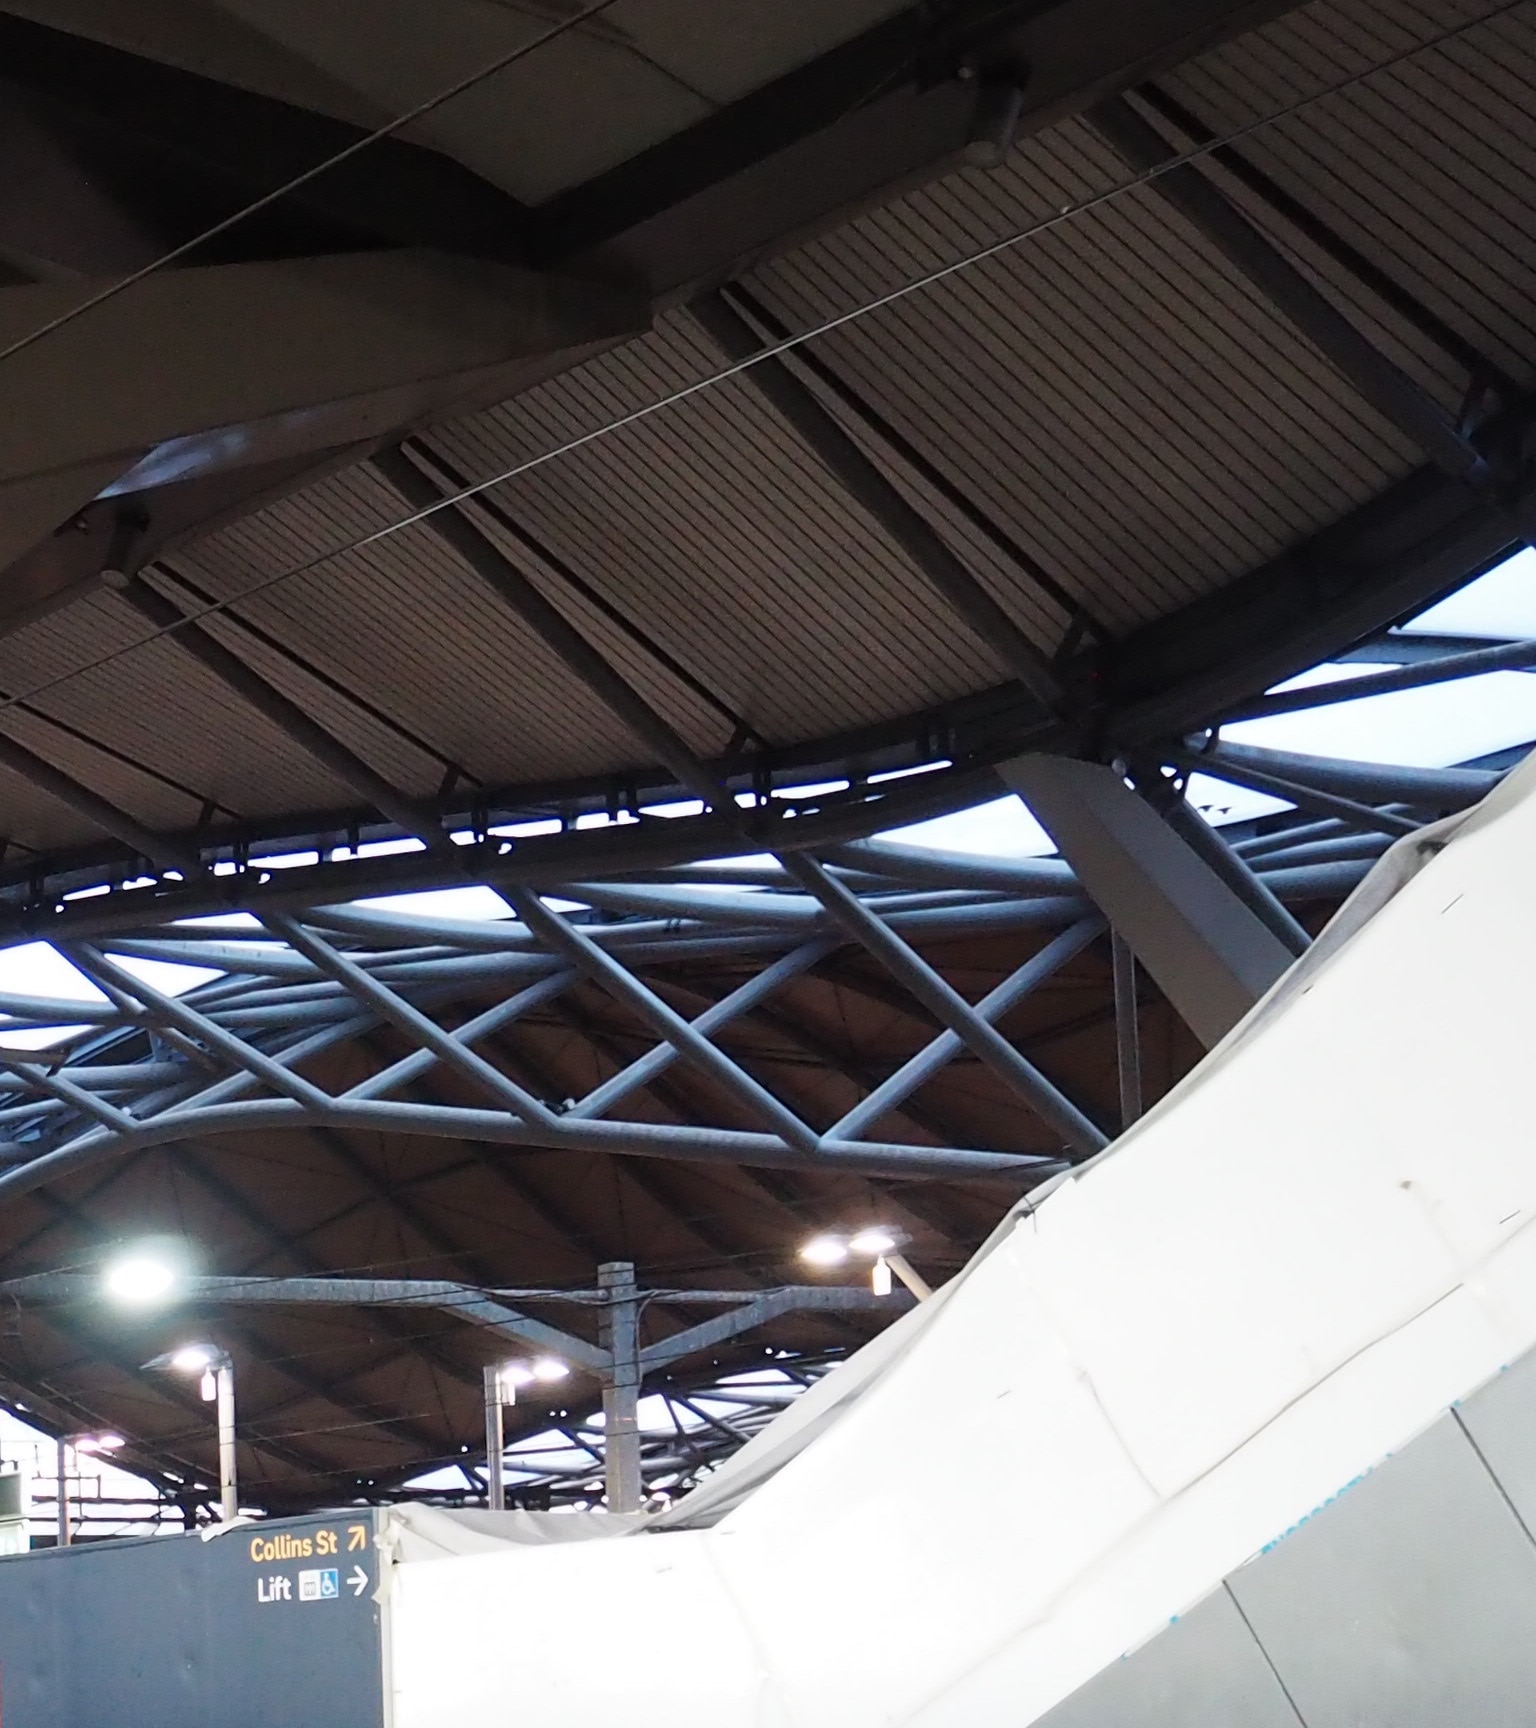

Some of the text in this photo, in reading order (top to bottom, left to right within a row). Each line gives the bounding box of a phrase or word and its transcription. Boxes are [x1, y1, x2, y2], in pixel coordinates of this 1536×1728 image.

[250, 1530, 338, 1562] Collins St
[257, 1575, 292, 1602] Lift
